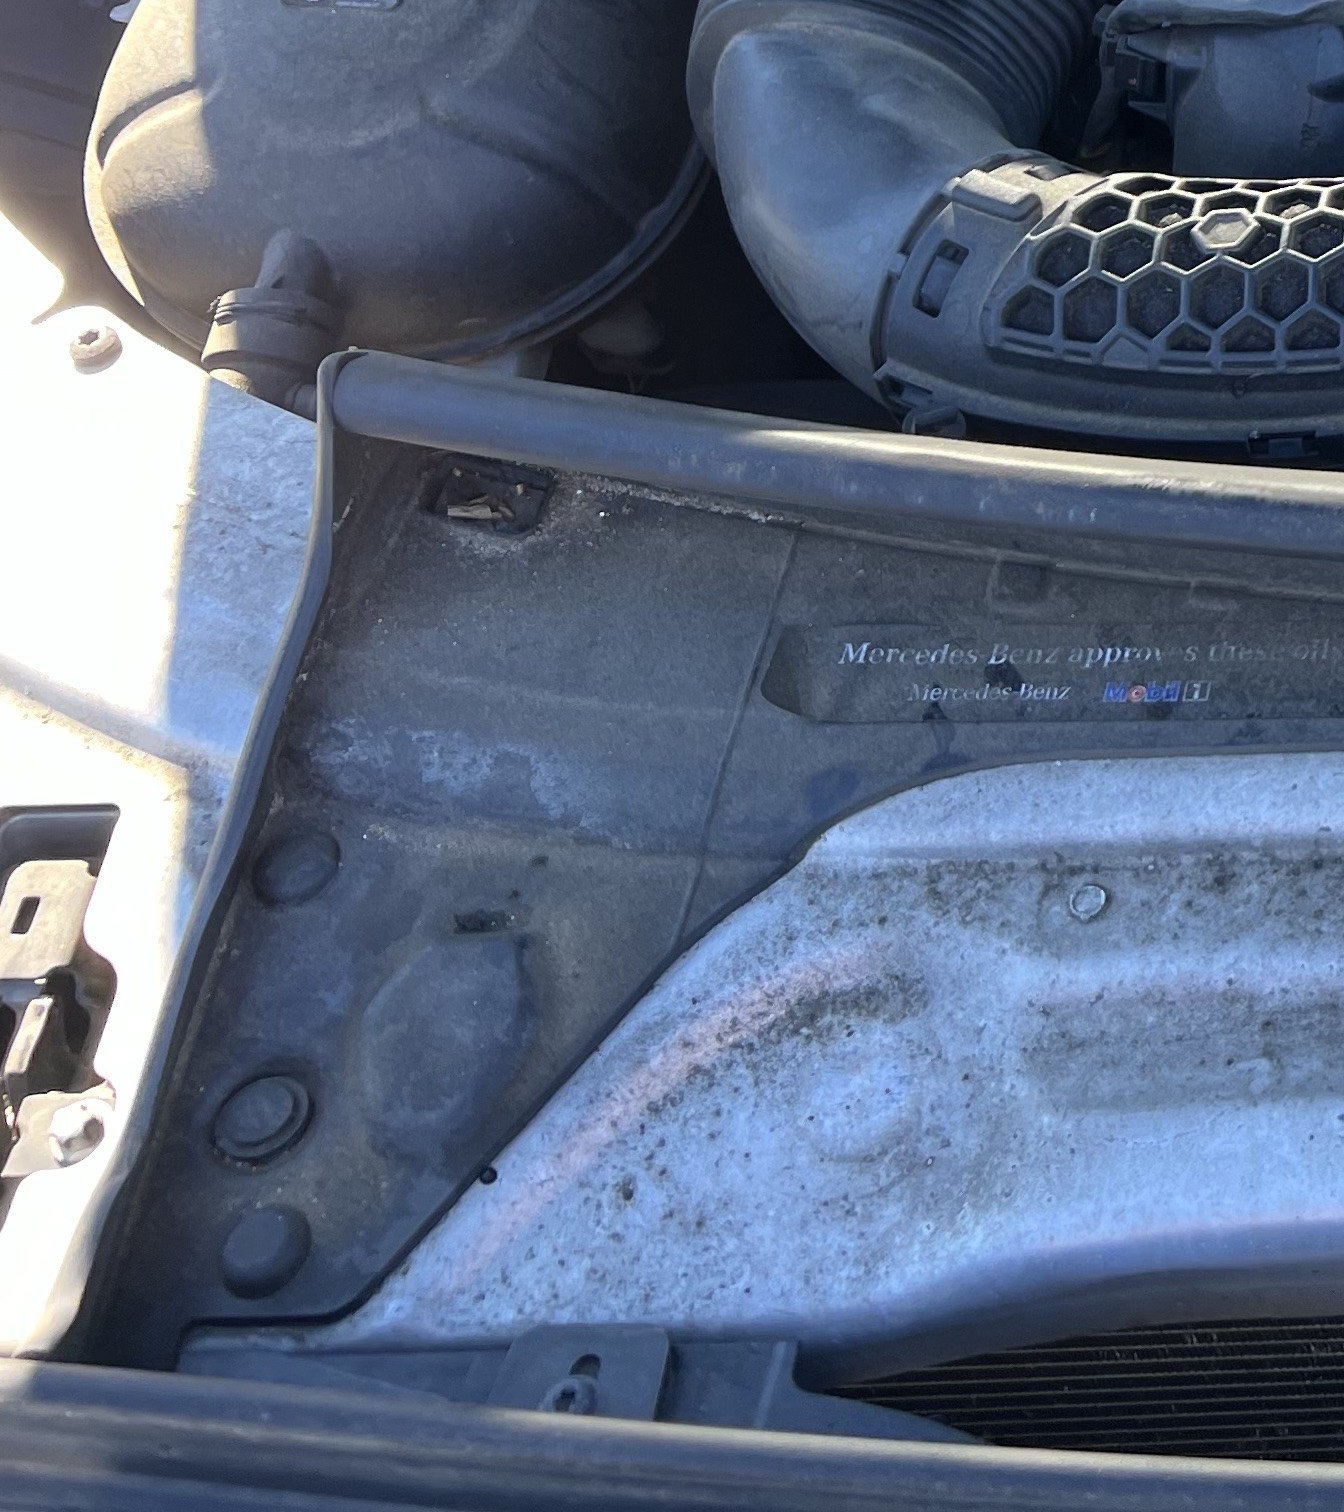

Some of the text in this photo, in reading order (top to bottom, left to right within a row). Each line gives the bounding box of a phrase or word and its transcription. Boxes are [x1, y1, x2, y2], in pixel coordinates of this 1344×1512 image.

[837, 641, 1060, 666] Mercedes-Benz
[907, 682, 1072, 702] Mercedes-Benz
[1102, 681, 1183, 703] Mobil
